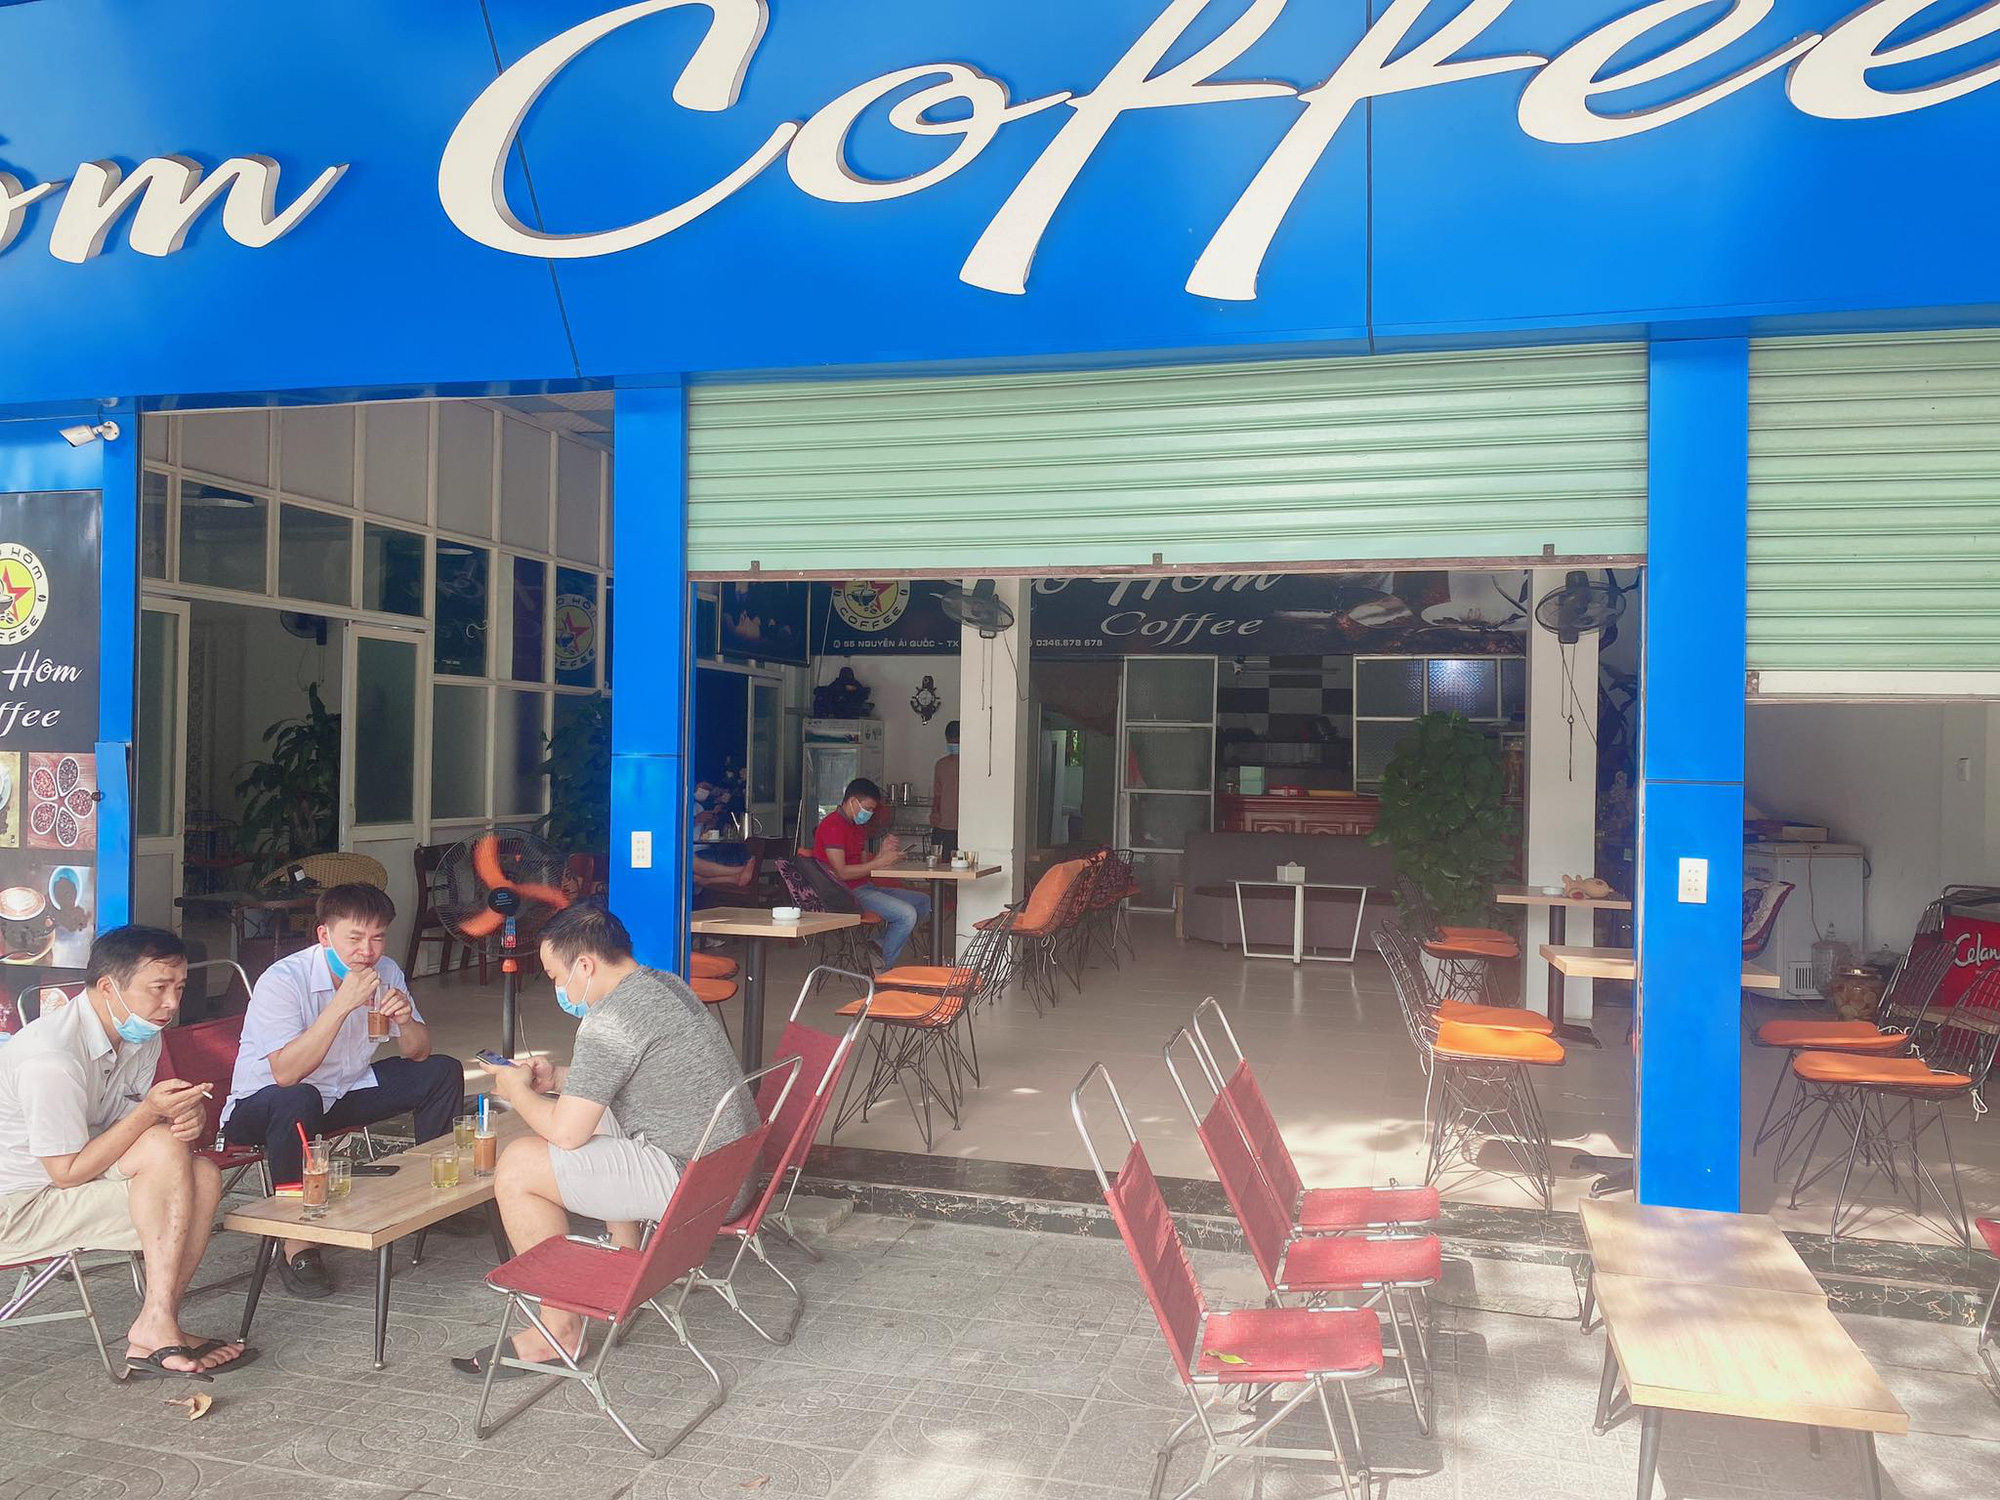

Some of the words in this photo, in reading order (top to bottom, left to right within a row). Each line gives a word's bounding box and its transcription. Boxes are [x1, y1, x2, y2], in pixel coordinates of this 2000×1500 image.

[438, 0, 2000, 301] Coffee
[840, 606, 902, 630] COFFEE
[1100, 611, 1264, 647] Coffee
[1, 648, 83, 692] Hôm
